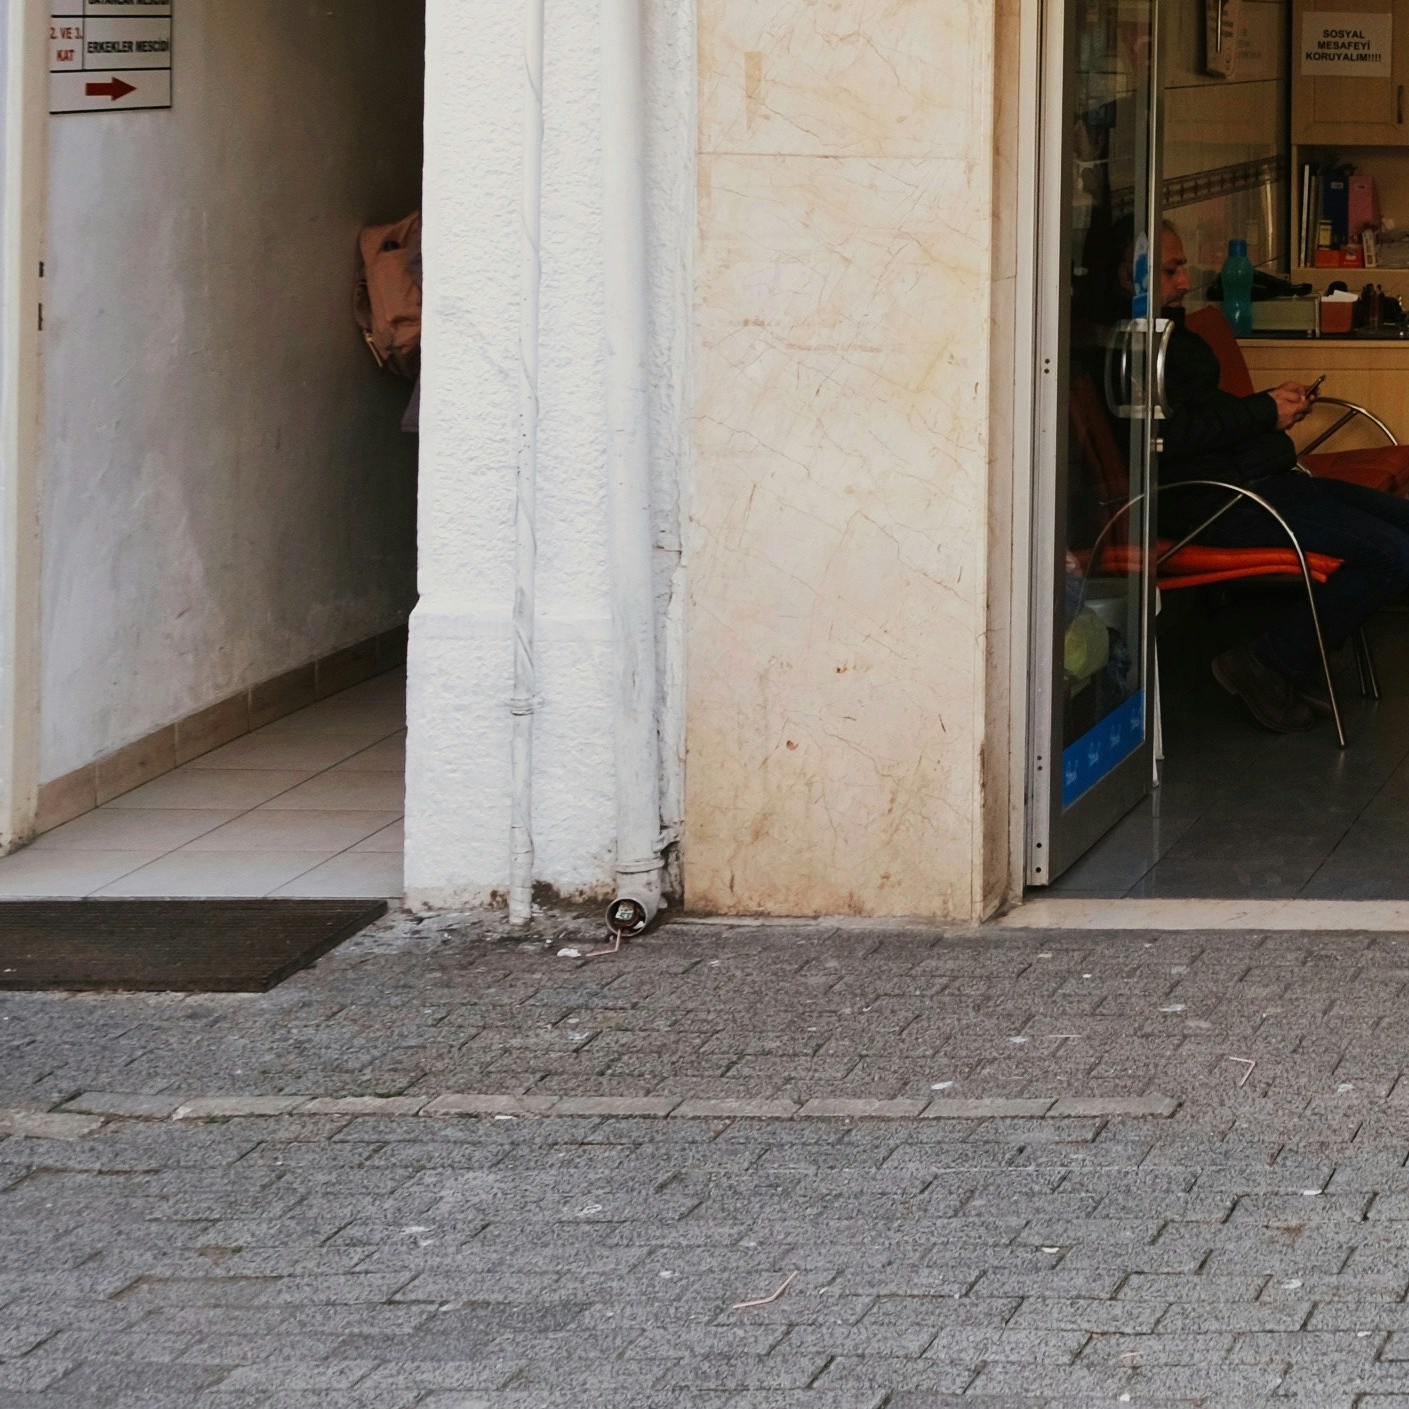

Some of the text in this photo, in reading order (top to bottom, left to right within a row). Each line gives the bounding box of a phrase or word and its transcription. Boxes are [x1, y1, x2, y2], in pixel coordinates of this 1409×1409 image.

[60, 27, 73, 40] VE
[1322, 29, 1365, 39] SOSYAL
[87, 40, 134, 53] ERKEKLER
[1317, 40, 1371, 51] MESAFEYİ
[56, 49, 75, 61] KAT
[1305, 52, 1382, 63] KORUYALIM!!!!
